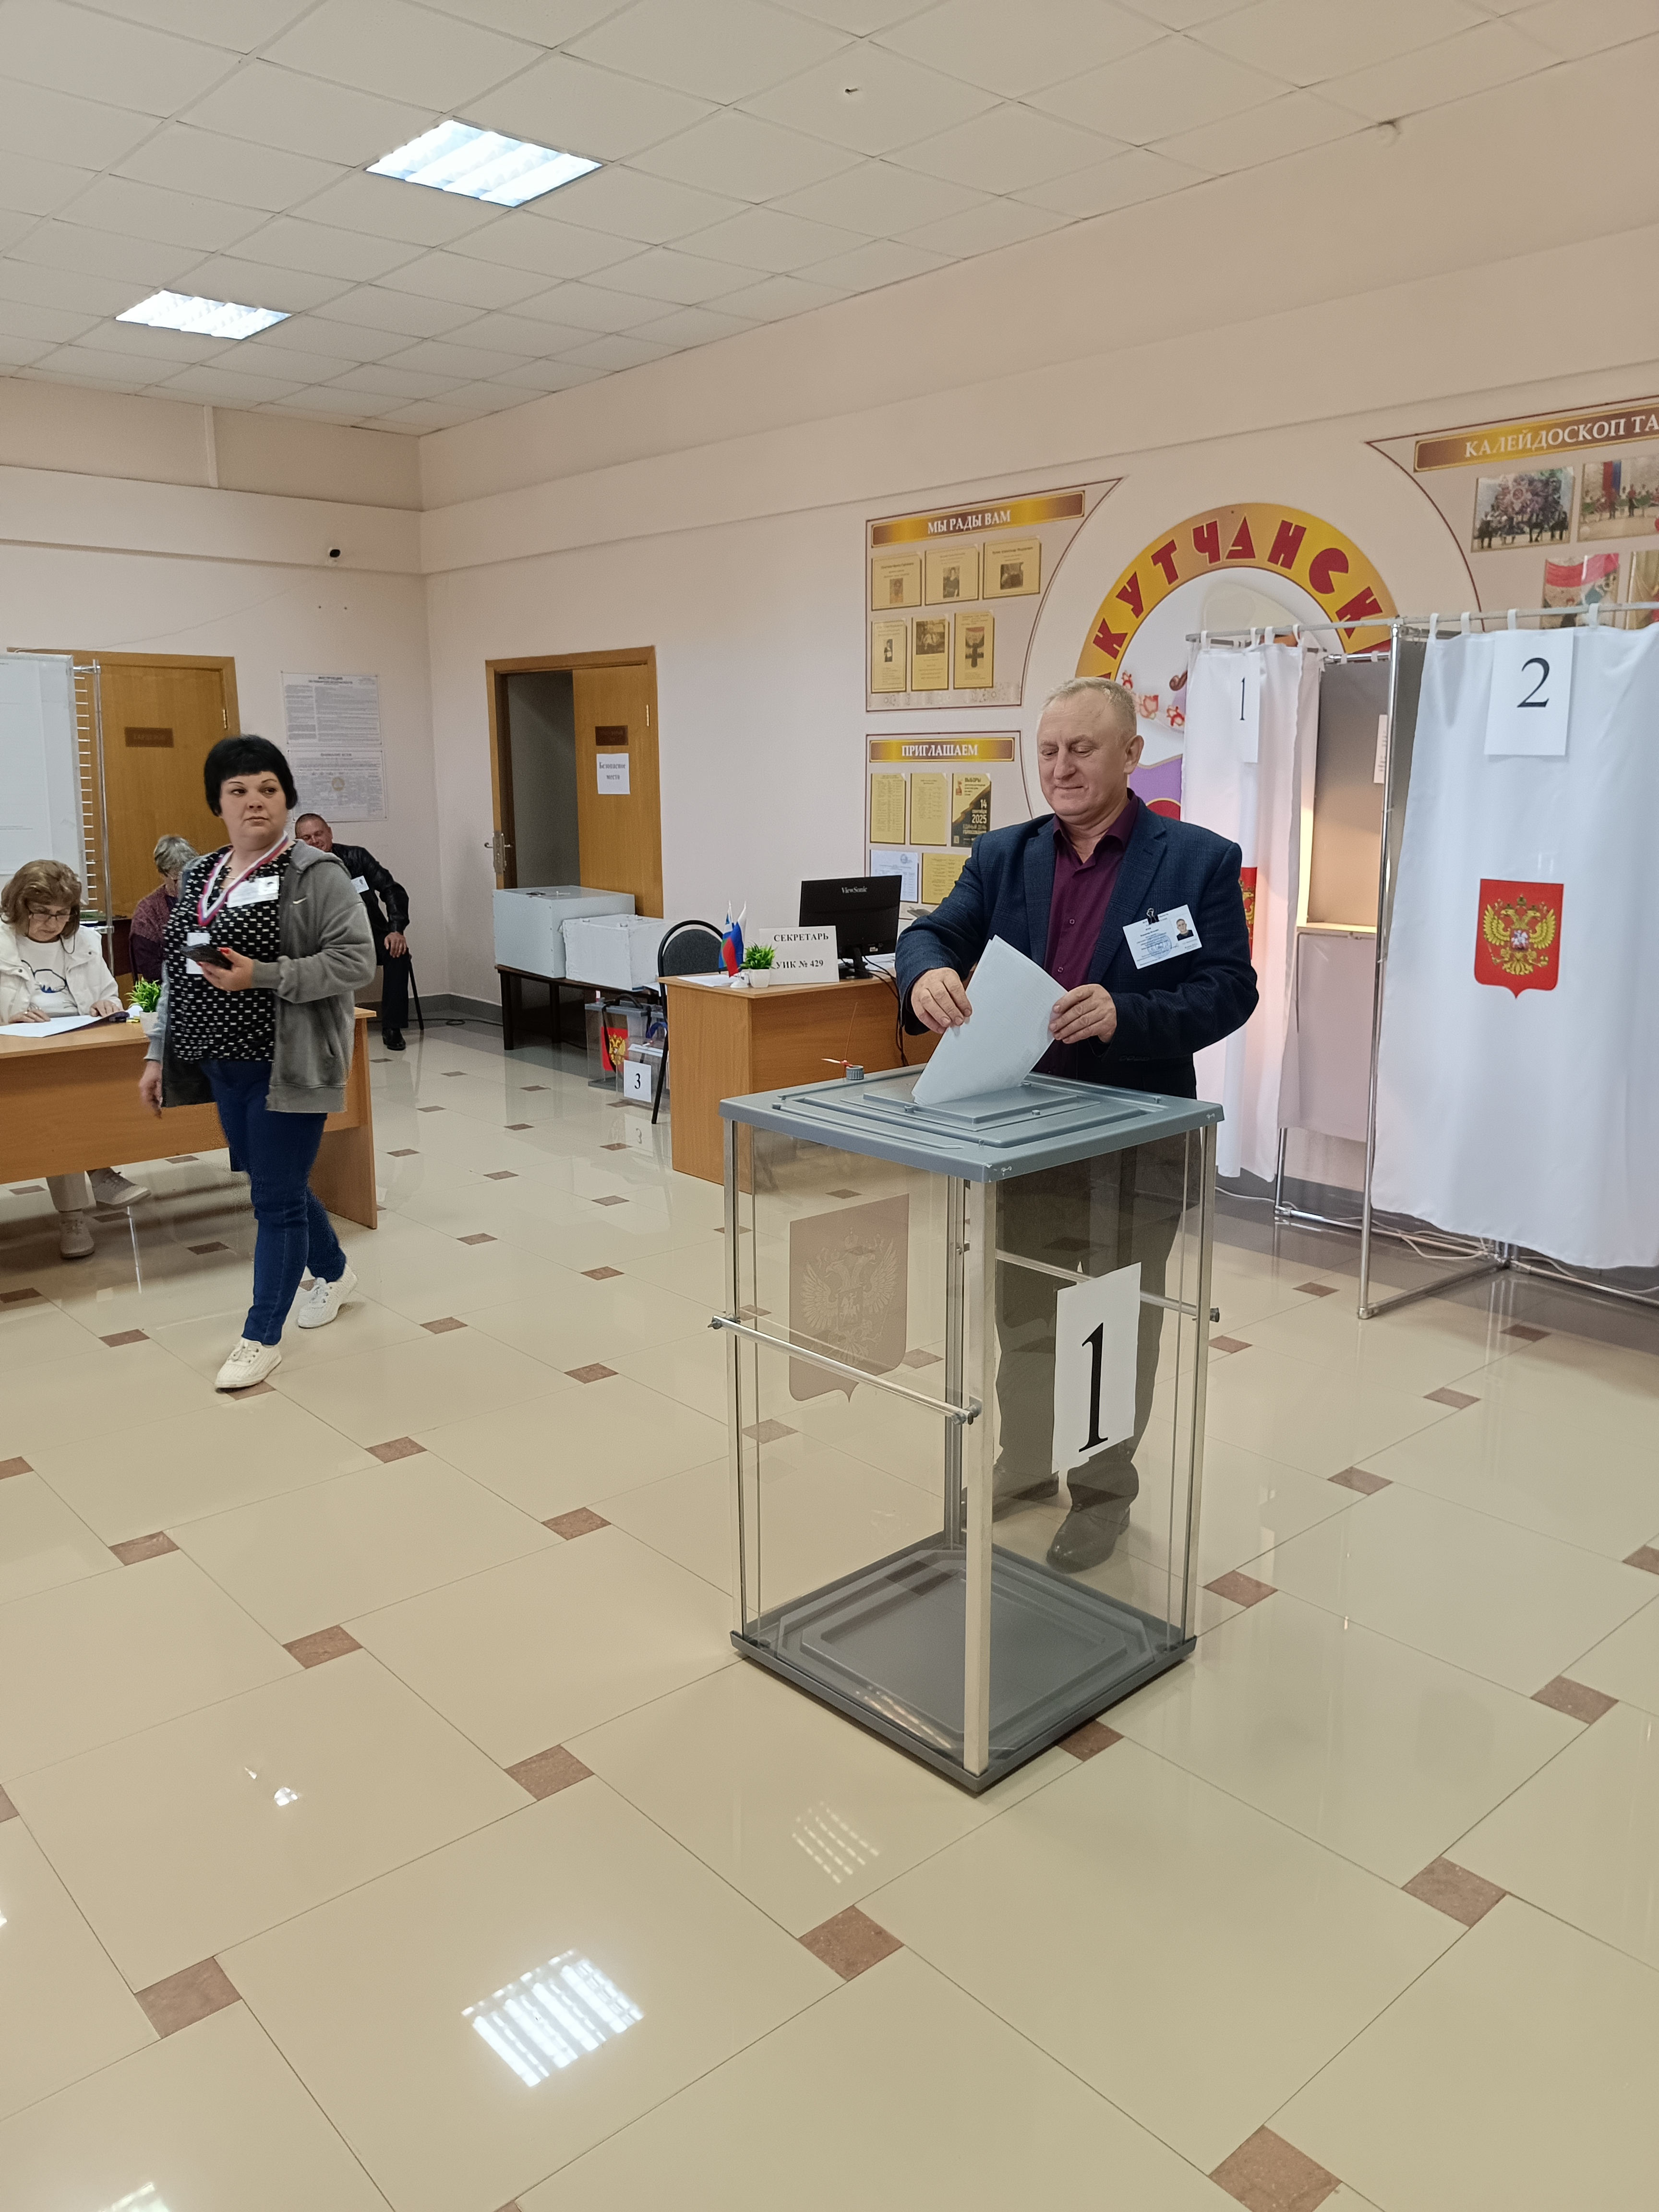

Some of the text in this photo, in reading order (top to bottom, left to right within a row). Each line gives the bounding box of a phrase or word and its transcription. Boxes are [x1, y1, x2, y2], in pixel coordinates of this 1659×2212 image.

[1464, 418, 1626, 458] КАЛЕЙДОСКОП
[927, 510, 1011, 534] МЫ РАДЫ ВАМ
[1093, 517, 1391, 678] КУТЧАНСК
[1517, 657, 1550, 708] 2
[1239, 677, 1245, 721] 1
[902, 744, 978, 757] ПРИГЛАШАЕМ
[980, 799, 987, 809] 14
[972, 814, 987, 824] 2025
[773, 933, 829, 942] СЕКРЕТАРЬ
[776, 961, 796, 969] УИК
[634, 1073, 641, 1089] 3
[1078, 1322, 1108, 1453] 1
